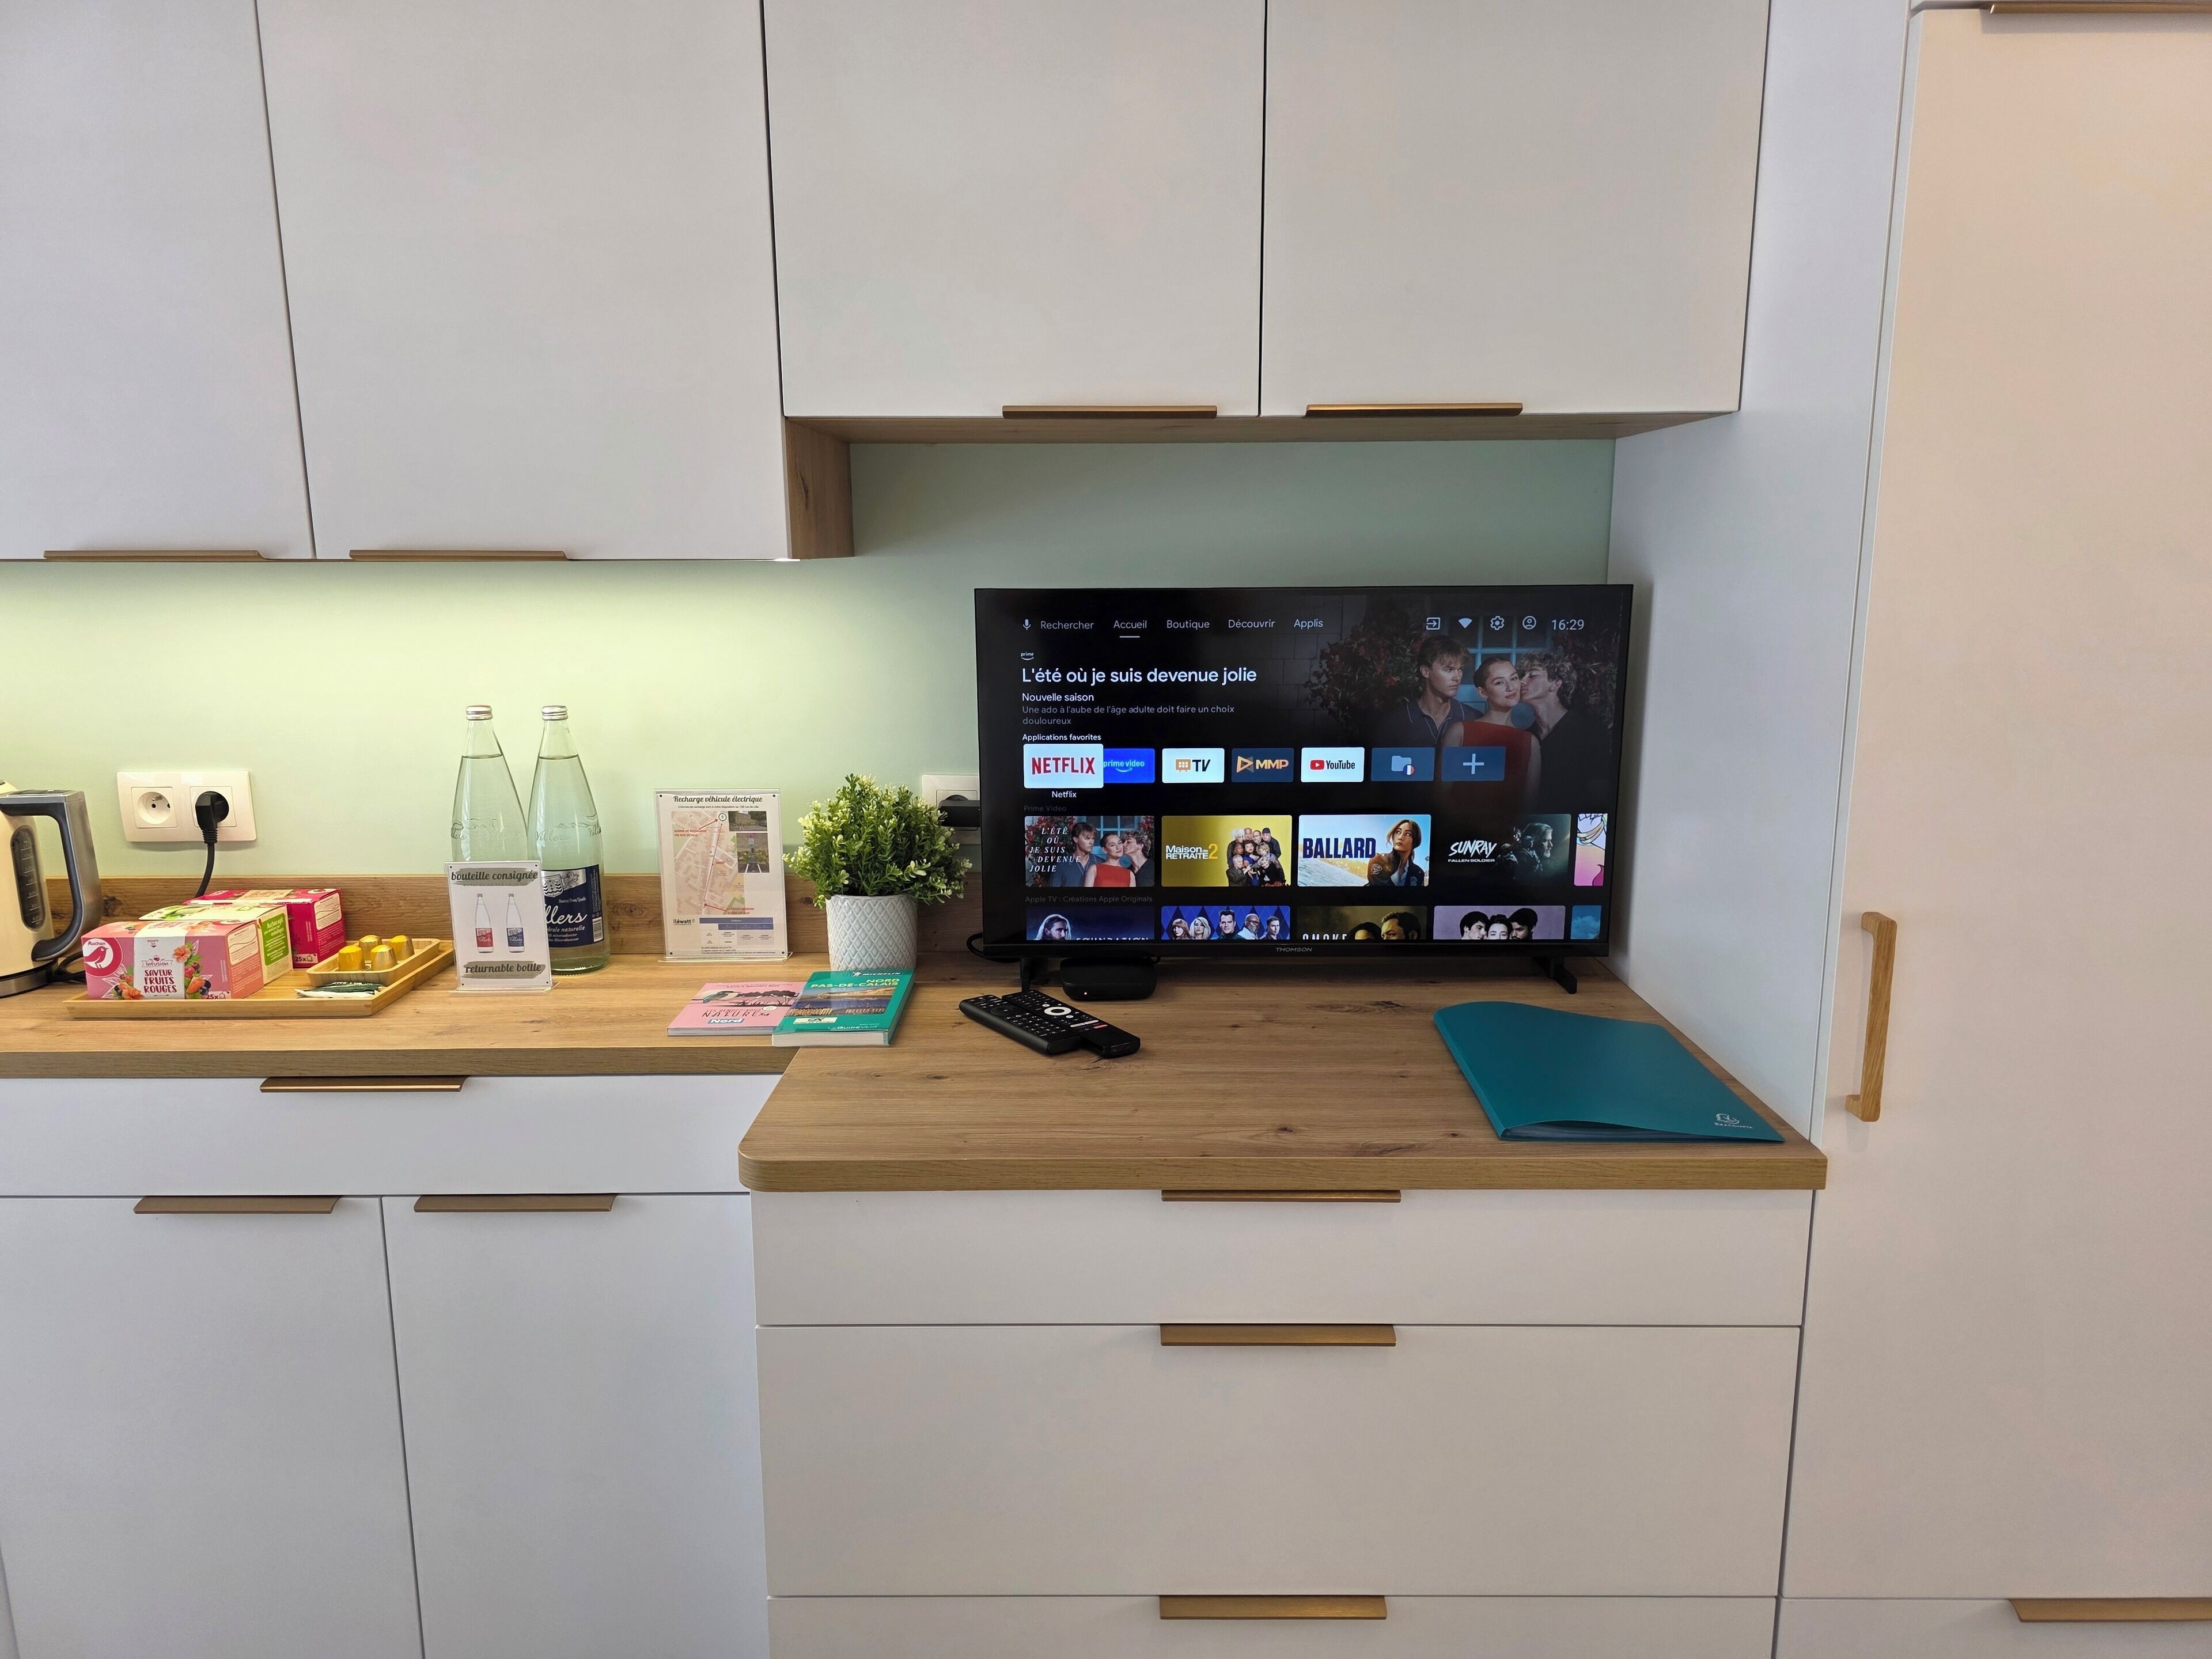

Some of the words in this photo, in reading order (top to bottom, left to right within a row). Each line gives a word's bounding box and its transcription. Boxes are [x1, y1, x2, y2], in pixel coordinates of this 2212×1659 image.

[1040, 620, 1094, 630] Rechercher
[1113, 620, 1147, 629] Accueil
[1166, 620, 1210, 630] Boutique
[1228, 619, 1275, 628] Découvrir
[1293, 619, 1323, 630] Applis
[1551, 619, 1585, 631] 16:29
[1022, 668, 1062, 683] L'été
[1066, 668, 1087, 683] où
[1090, 668, 1105, 686] je
[1110, 668, 1142, 683] suis
[1147, 668, 1219, 683] devenue
[1222, 667, 1257, 685] jolie
[1022, 693, 1062, 702] Nouvelle
[1064, 693, 1094, 702] saison
[1022, 706, 1040, 714] Une
[1041, 706, 1058, 714] ado
[1059, 706, 1065, 714] à
[1066, 706, 1092, 714] l'aube
[1093, 706, 1105, 714] de
[1107, 706, 1127, 715] l'âge
[1128, 706, 1155, 714] adulte
[1157, 705, 1175, 713] doit
[1176, 705, 1196, 713] faire
[1210, 705, 1234, 713] choix
[1022, 734, 1067, 742] Applications
[1032, 757, 1095, 775] NETFLIX
[1103, 759, 1124, 768] prime
[1125, 759, 1145, 767] video
[1192, 759, 1211, 772] TV
[1256, 759, 1289, 769] MMP
[1325, 760, 1355, 770] YouTube
[673, 796, 704, 804] Recharge
[732, 796, 763, 804] électrique
[1047, 835, 1059, 844] OÙ
[1165, 845, 1202, 853] Maison
[1208, 843, 1218, 859] 2
[1302, 838, 1376, 859] BALLARD
[1448, 839, 1498, 858] SUNRAY
[451, 871, 490, 881] bouteille
[492, 870, 538, 882] consignée
[545, 904, 588, 925] llers
[465, 964, 514, 973] returnable
[516, 963, 541, 972] bottle
[144, 976, 175, 984] FRUITS
[143, 984, 177, 994] ROUGES
